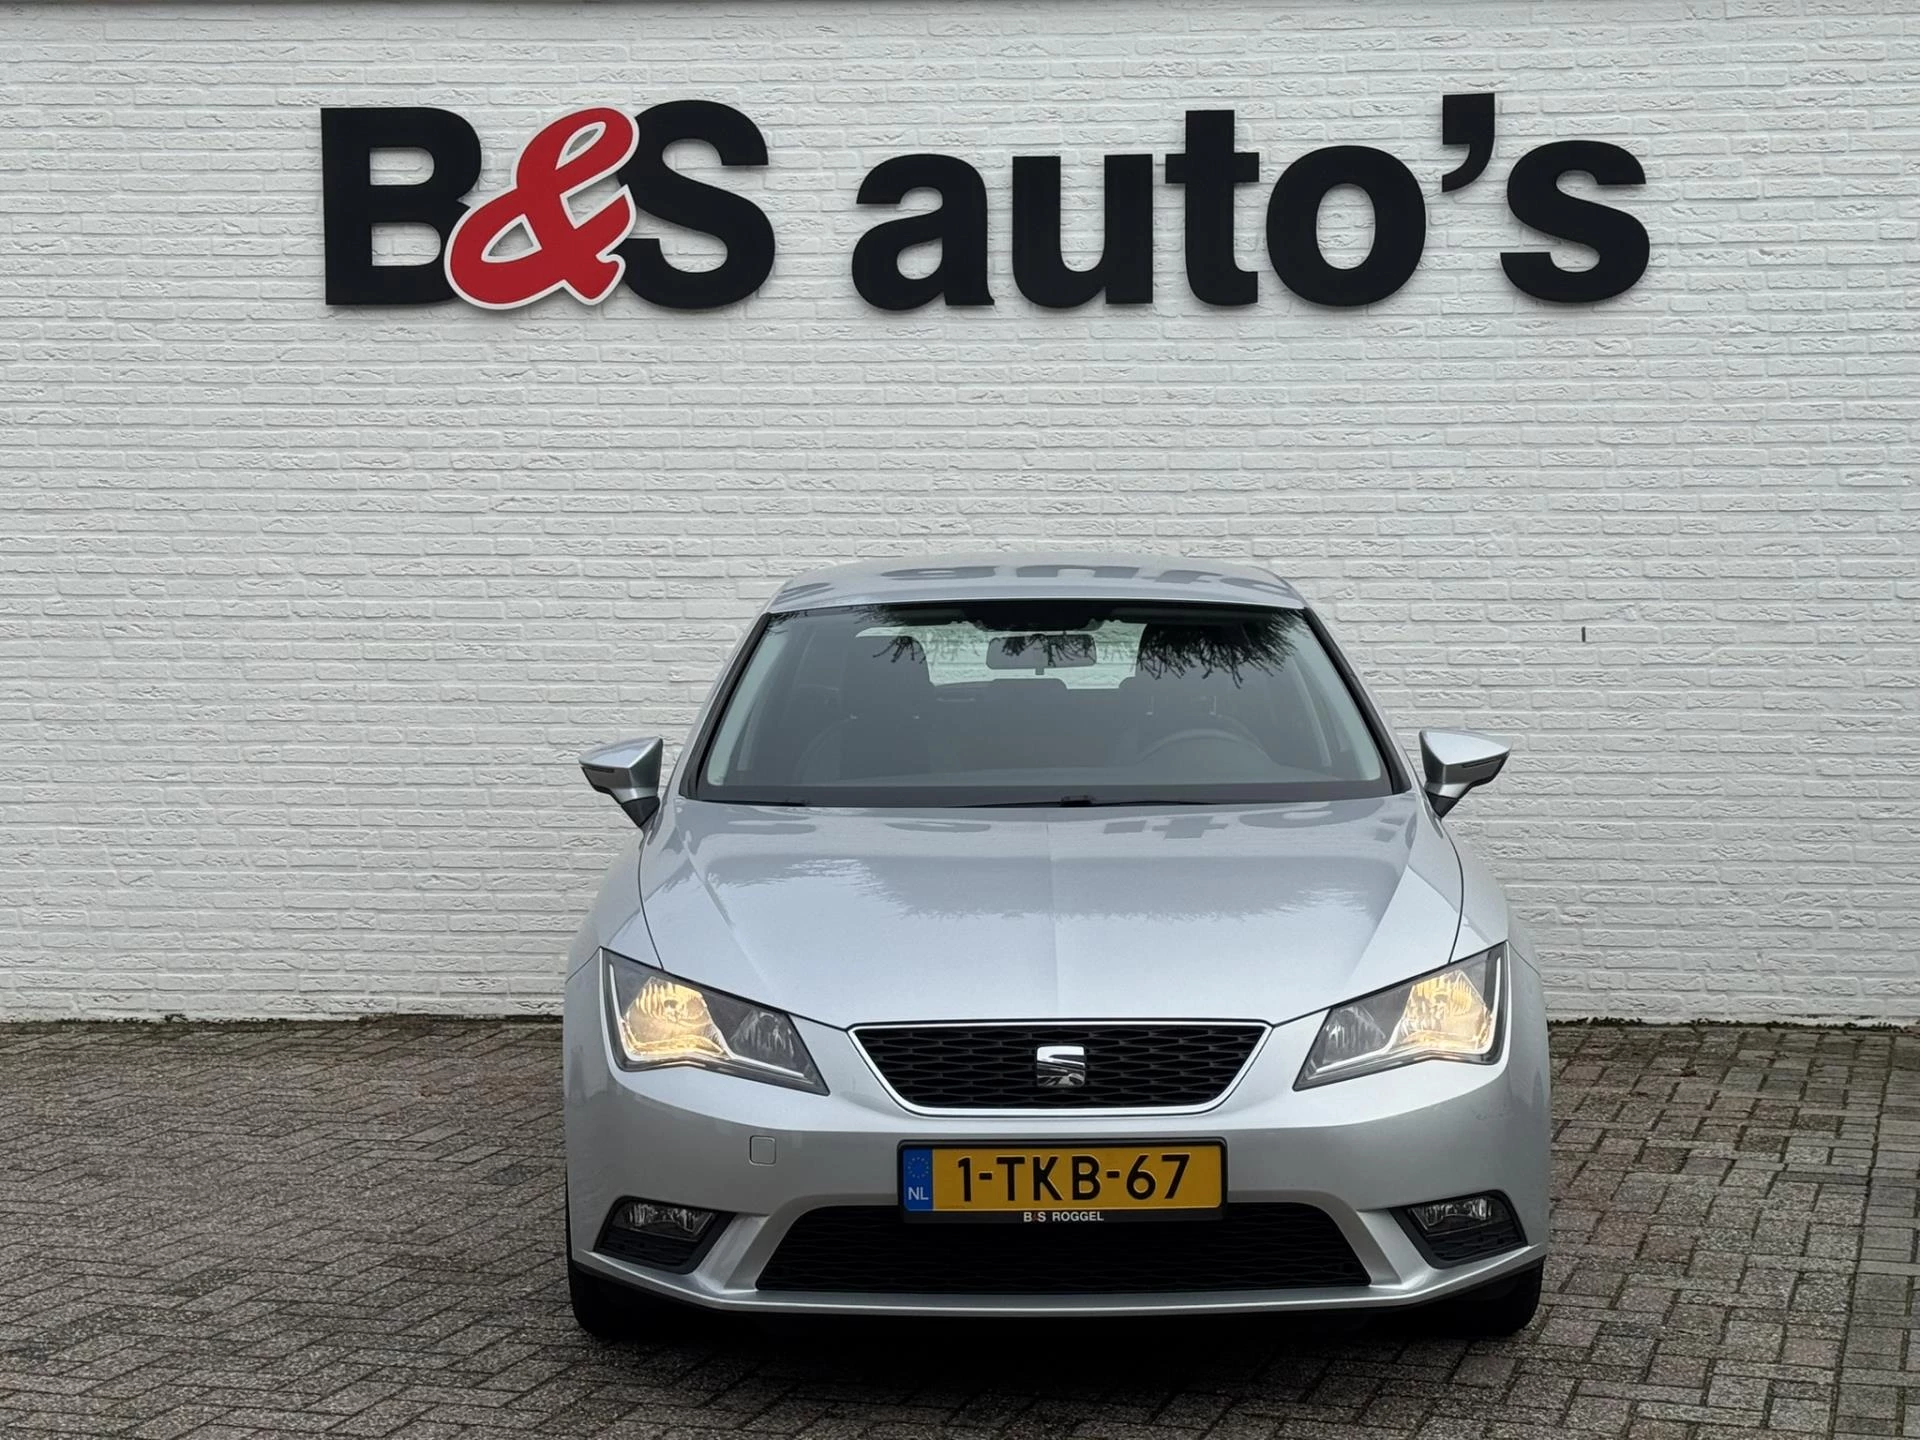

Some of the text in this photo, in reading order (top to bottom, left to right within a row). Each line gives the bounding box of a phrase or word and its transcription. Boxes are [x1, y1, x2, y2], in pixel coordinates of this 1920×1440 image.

[321, 93, 1650, 311] B&S auto's
[957, 1153, 1190, 1202] 1-TKB-67
[907, 1187, 930, 1201] NL
[1052, 1211, 1105, 1222] ROGGEL
